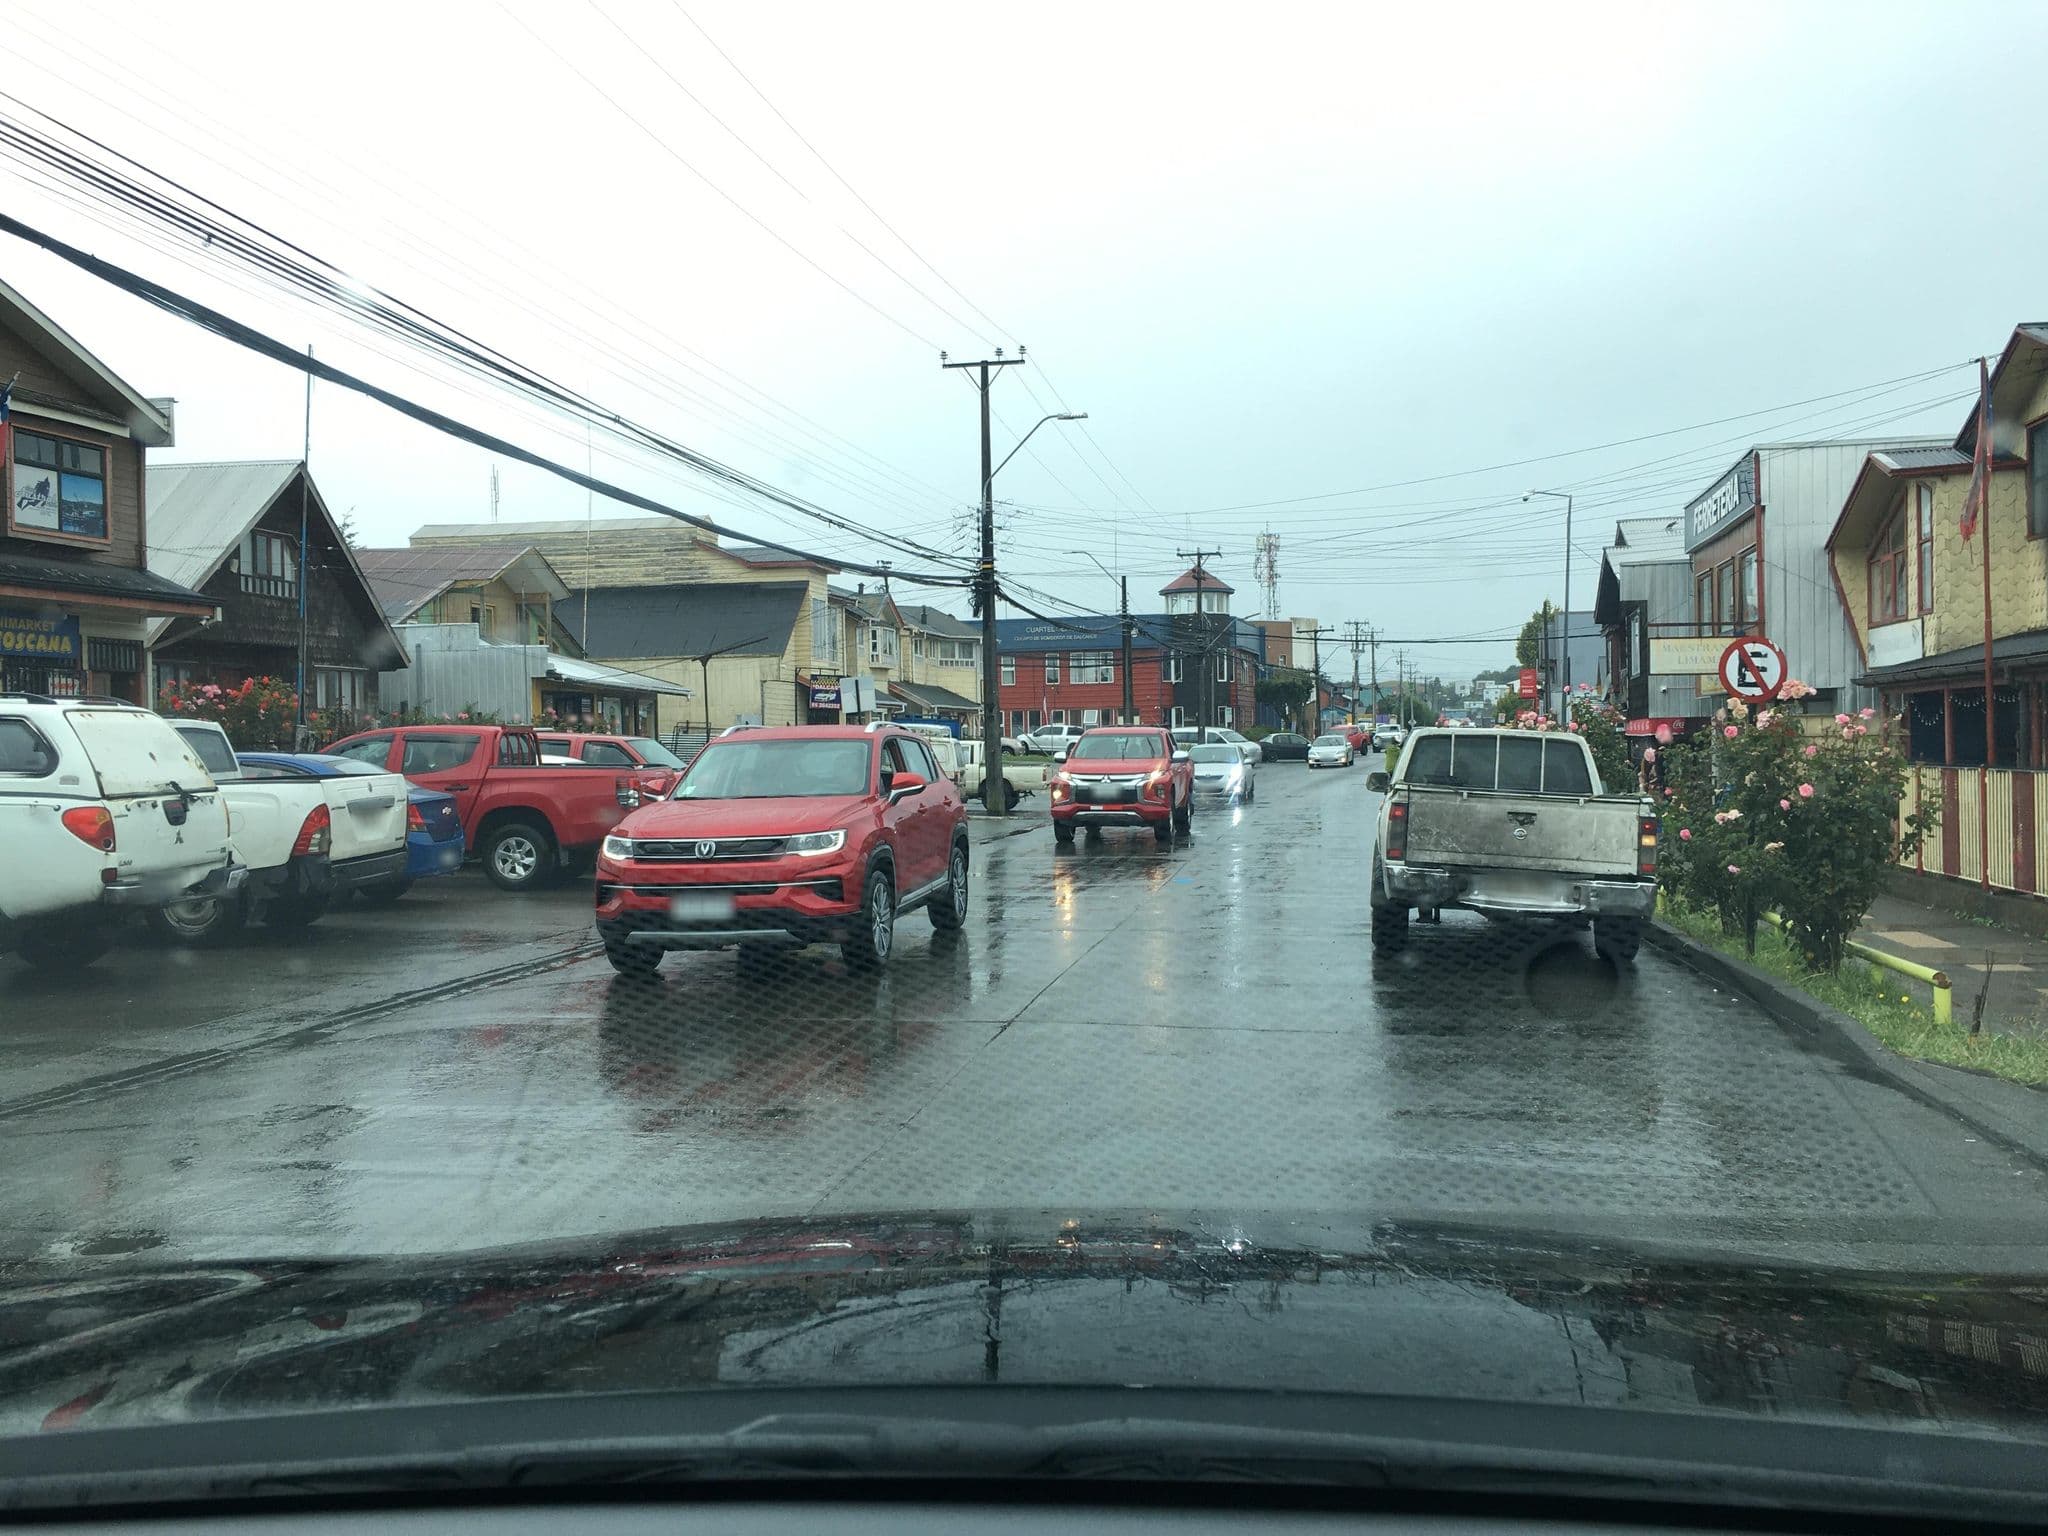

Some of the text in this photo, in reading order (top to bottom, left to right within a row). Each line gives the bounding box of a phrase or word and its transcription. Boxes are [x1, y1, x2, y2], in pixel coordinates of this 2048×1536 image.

[1694, 473, 1740, 536] FERRETERIA
[1025, 626, 1055, 634] CUARTEL
[0, 631, 72, 653] OSCANA
